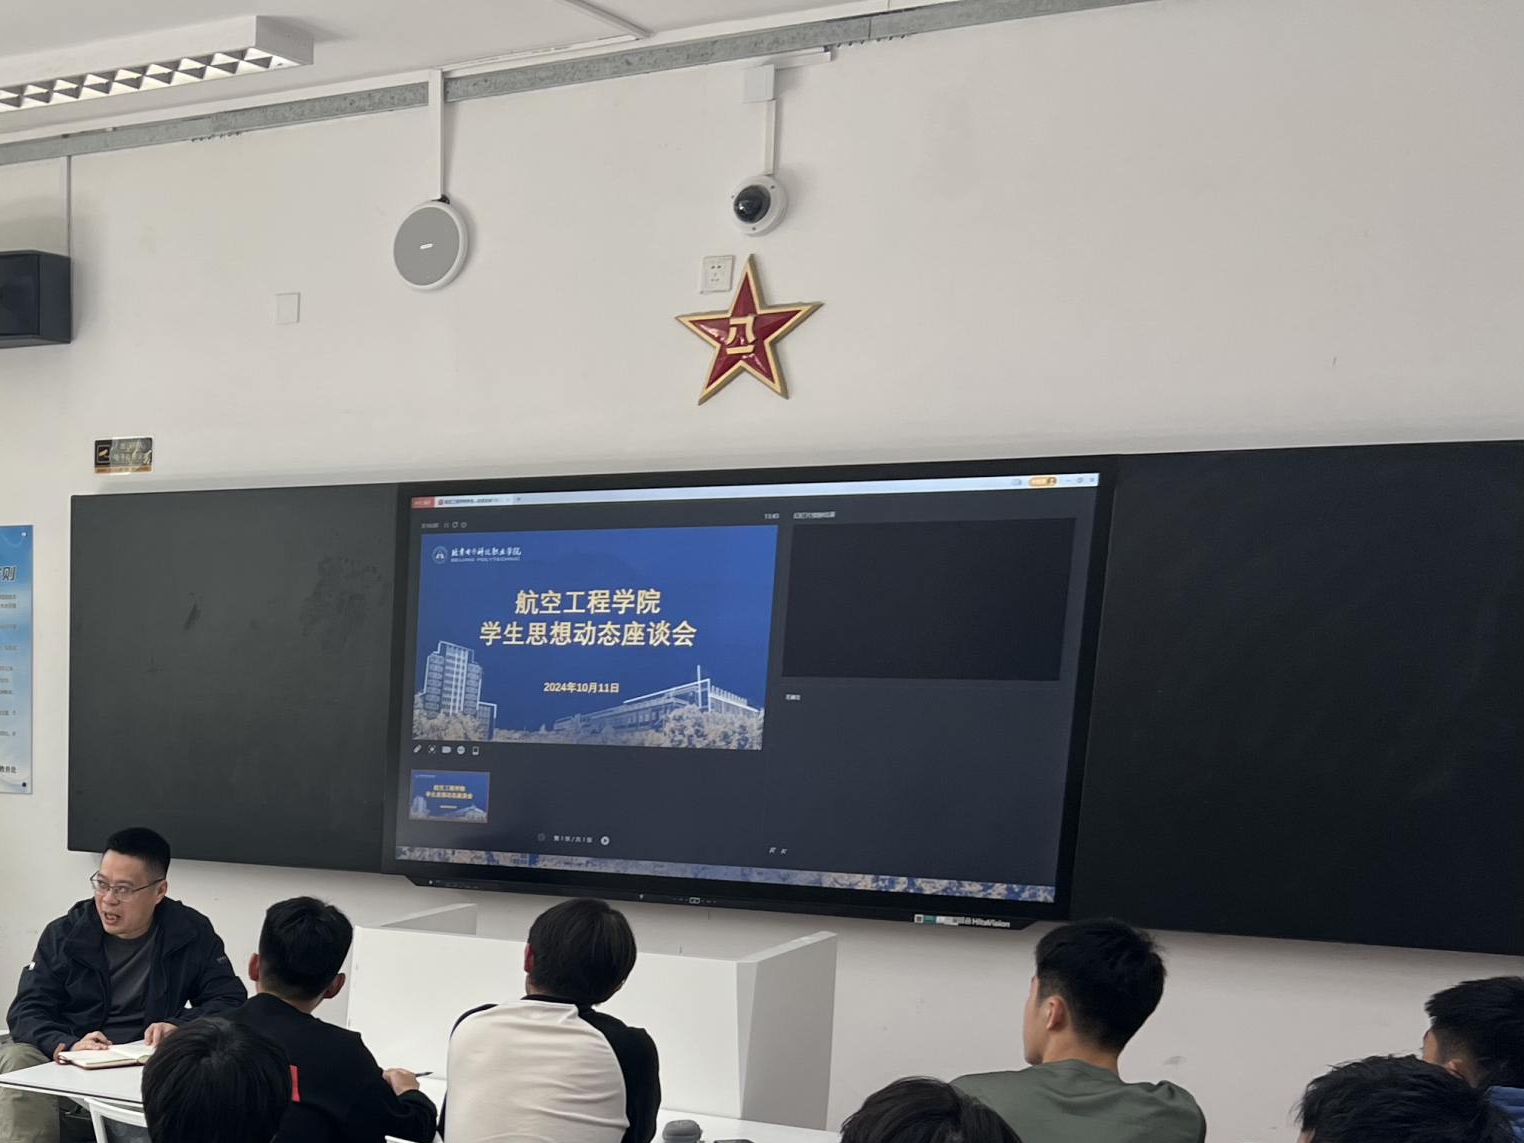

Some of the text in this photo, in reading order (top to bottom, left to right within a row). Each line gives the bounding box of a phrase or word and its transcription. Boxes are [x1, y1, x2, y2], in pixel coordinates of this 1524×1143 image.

[725, 314, 757, 355] 八一
[514, 587, 662, 617] 航空工程学院
[479, 619, 697, 648] 学生思想动态座谈会
[543, 681, 621, 695] 2024年10月11日
